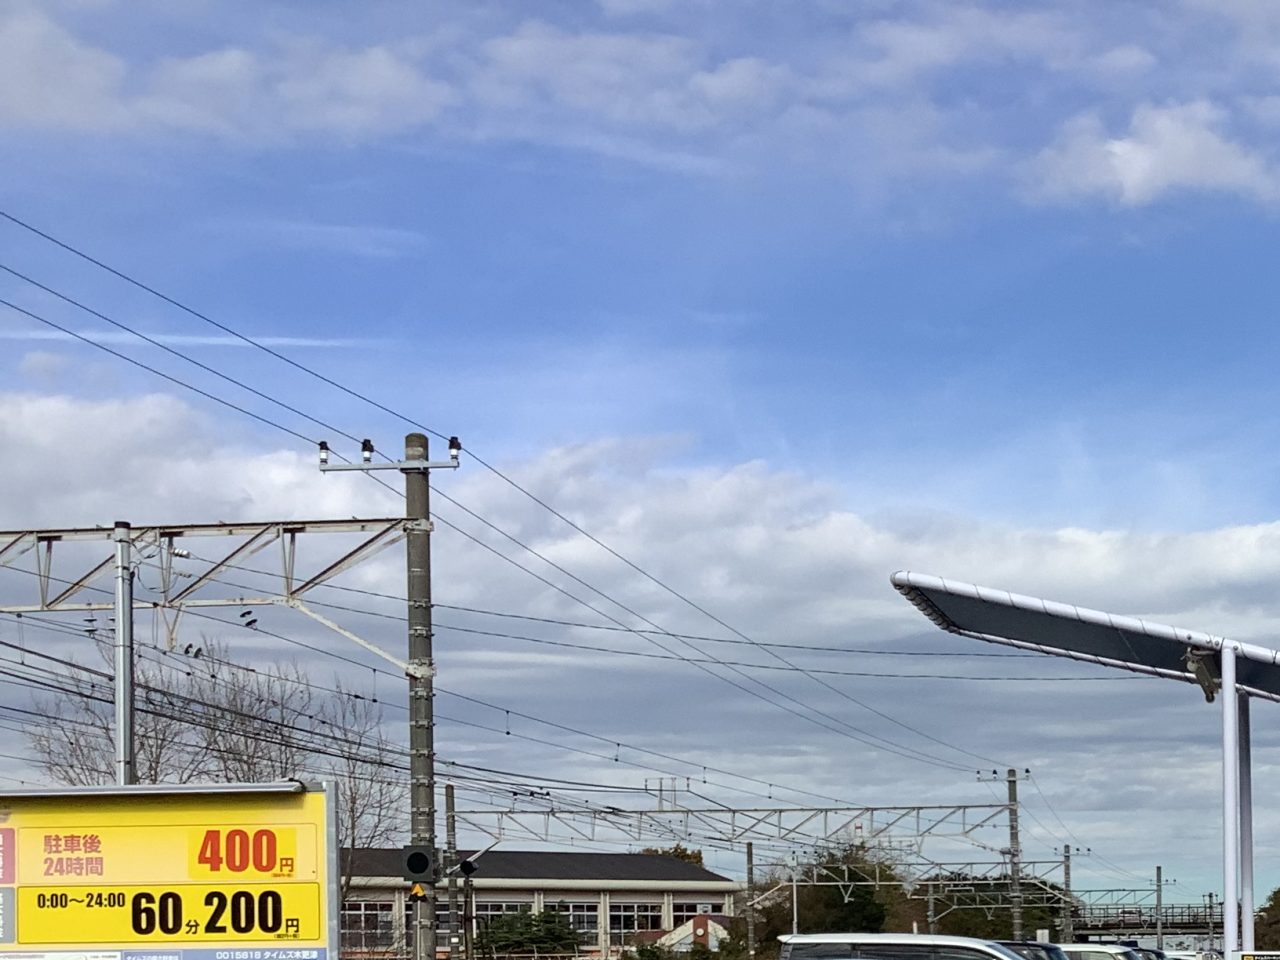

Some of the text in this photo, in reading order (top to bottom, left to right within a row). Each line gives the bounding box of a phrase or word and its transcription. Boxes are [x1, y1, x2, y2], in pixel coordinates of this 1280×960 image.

[43, 834, 102, 854] 駐車後
[198, 829, 294, 873] 400円
[43, 857, 104, 876] 24時間
